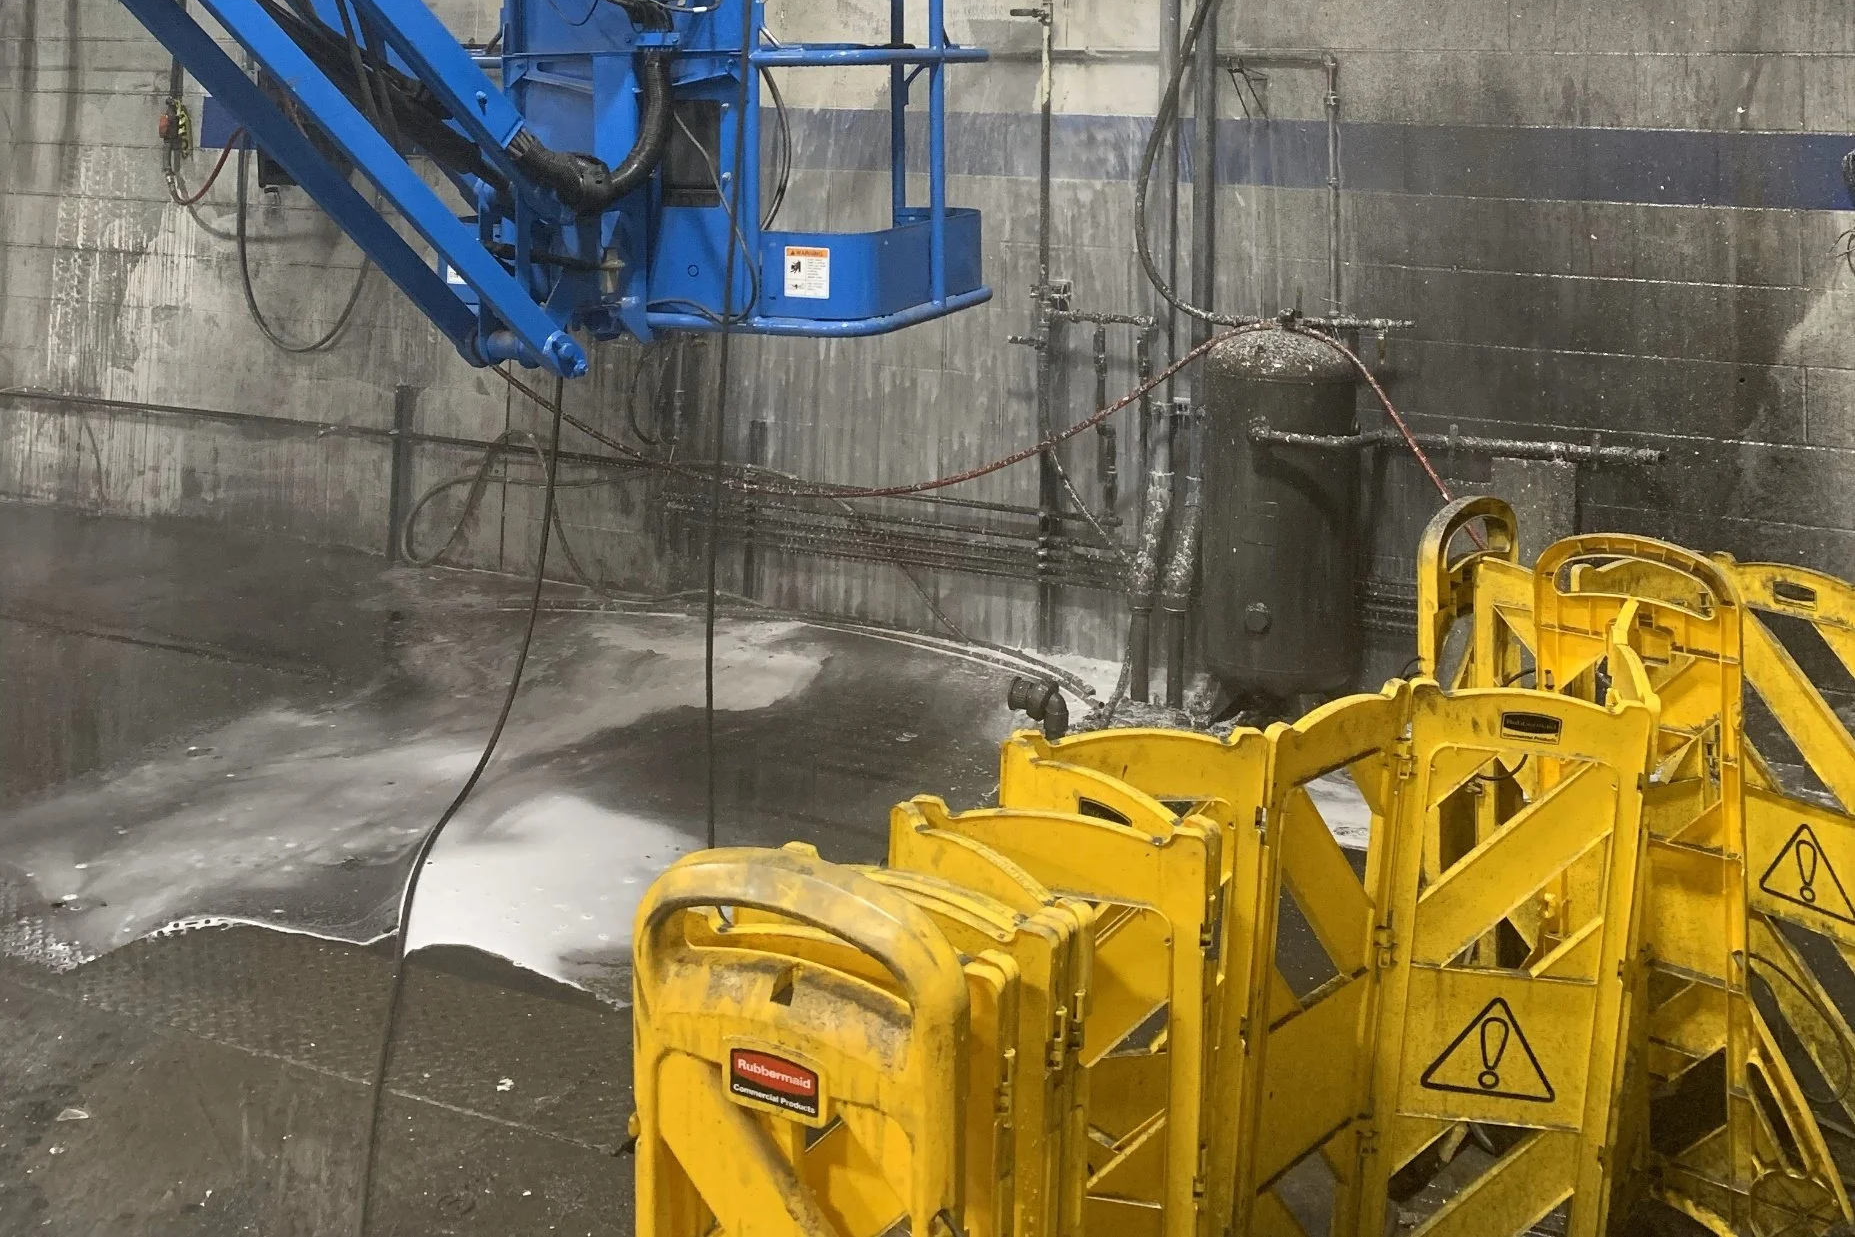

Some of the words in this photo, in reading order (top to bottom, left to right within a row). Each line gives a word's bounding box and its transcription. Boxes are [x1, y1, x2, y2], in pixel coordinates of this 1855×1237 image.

[737, 1058, 811, 1089] Rubbermaid
[733, 1083, 779, 1103] Commercial
[780, 1097, 816, 1114] Products
